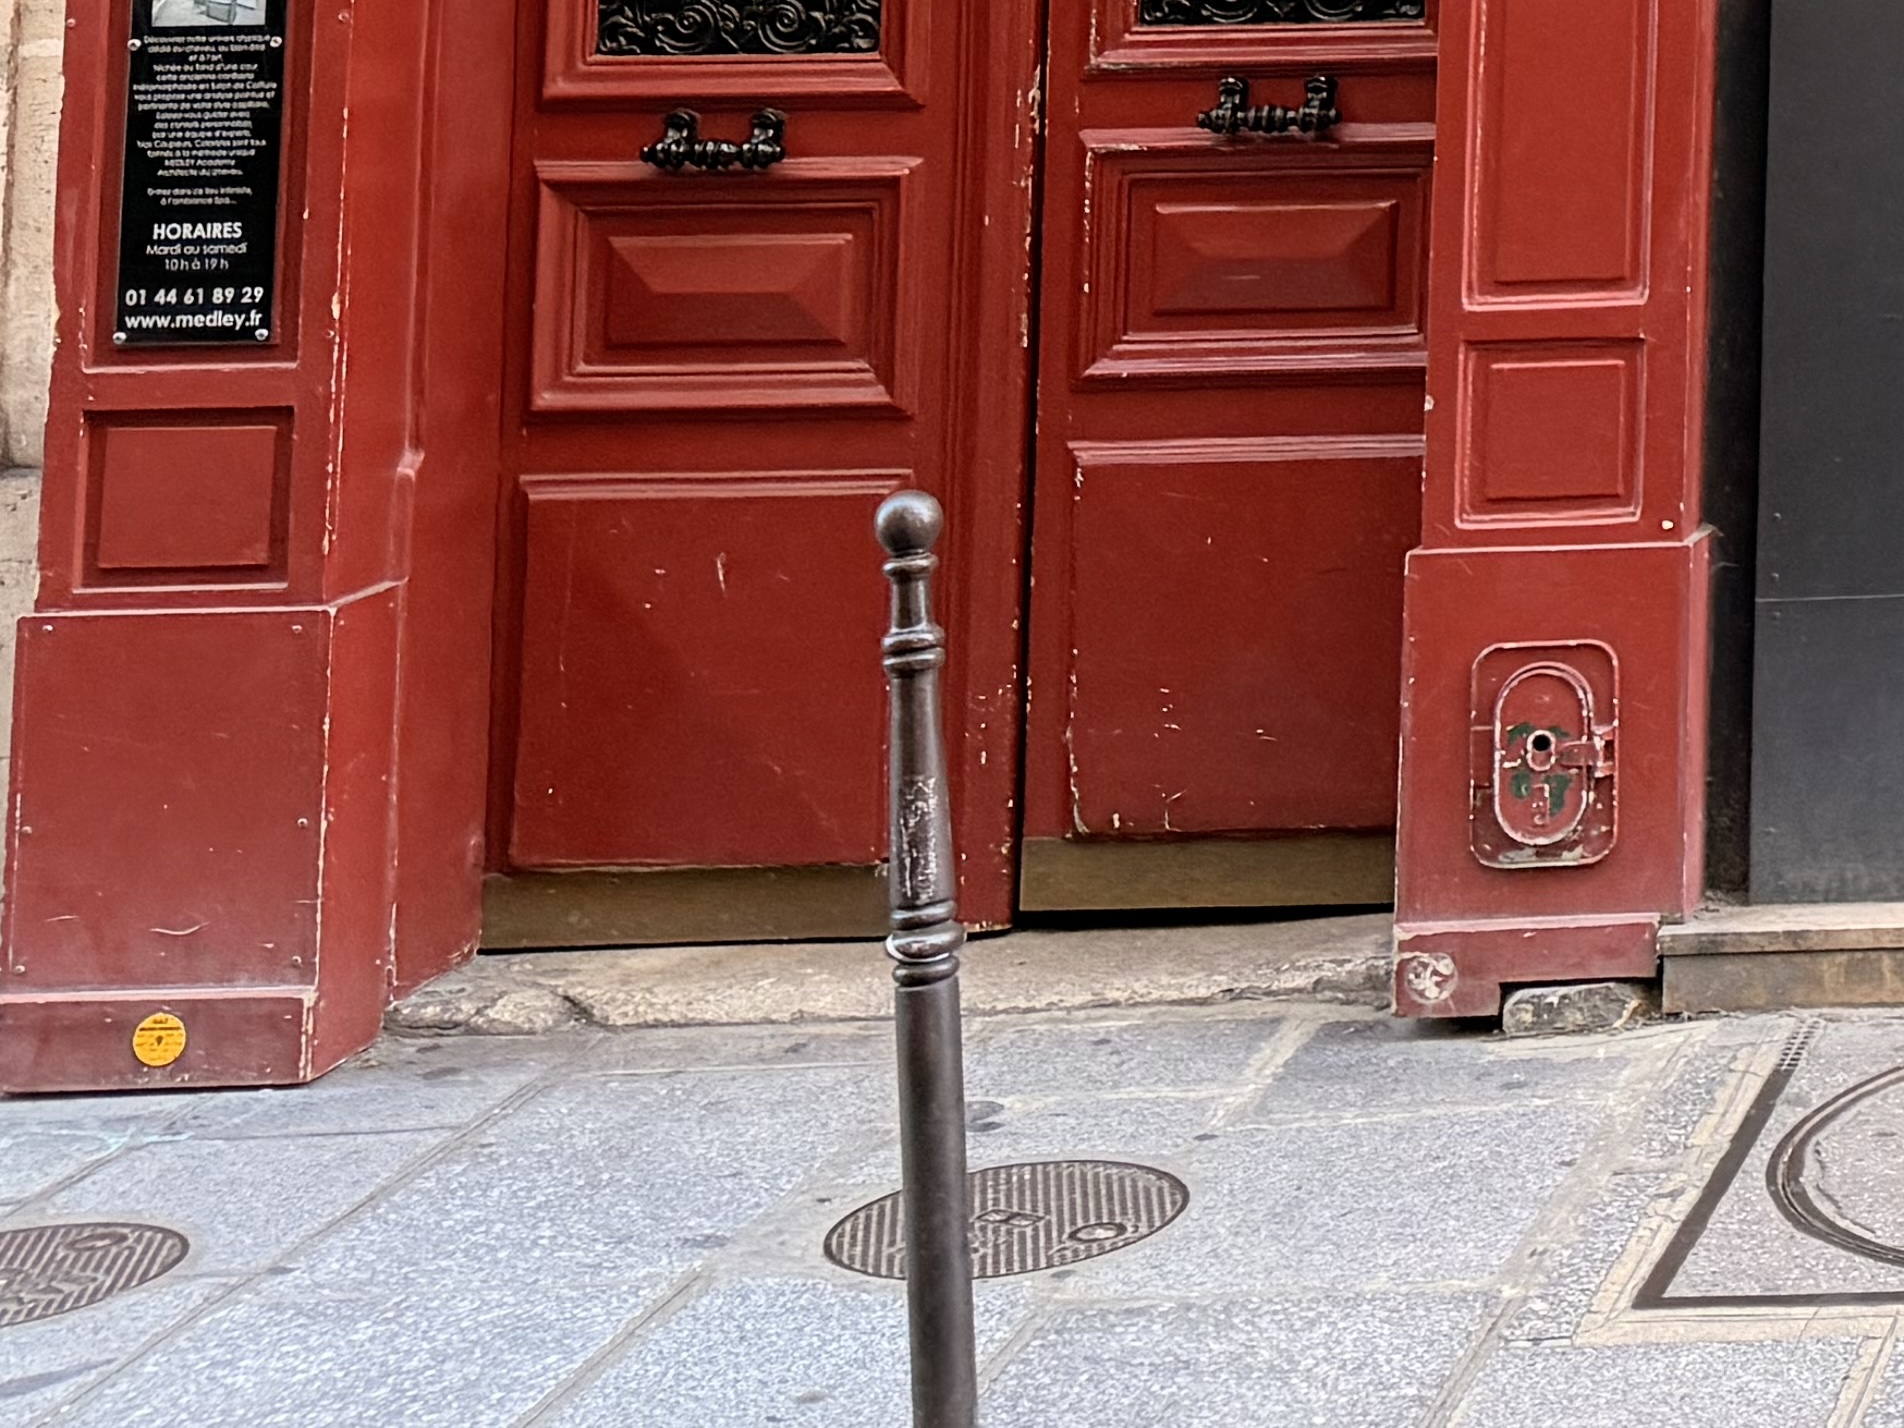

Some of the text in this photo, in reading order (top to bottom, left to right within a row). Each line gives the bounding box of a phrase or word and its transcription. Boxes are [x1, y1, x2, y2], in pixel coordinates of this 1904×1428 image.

[153, 222, 242, 240] HORAIRES
[146, 242, 248, 255] Mardi au samedi
[125, 286, 264, 306] 01 44 61 89 29
[125, 309, 262, 331] www.medley.fr
